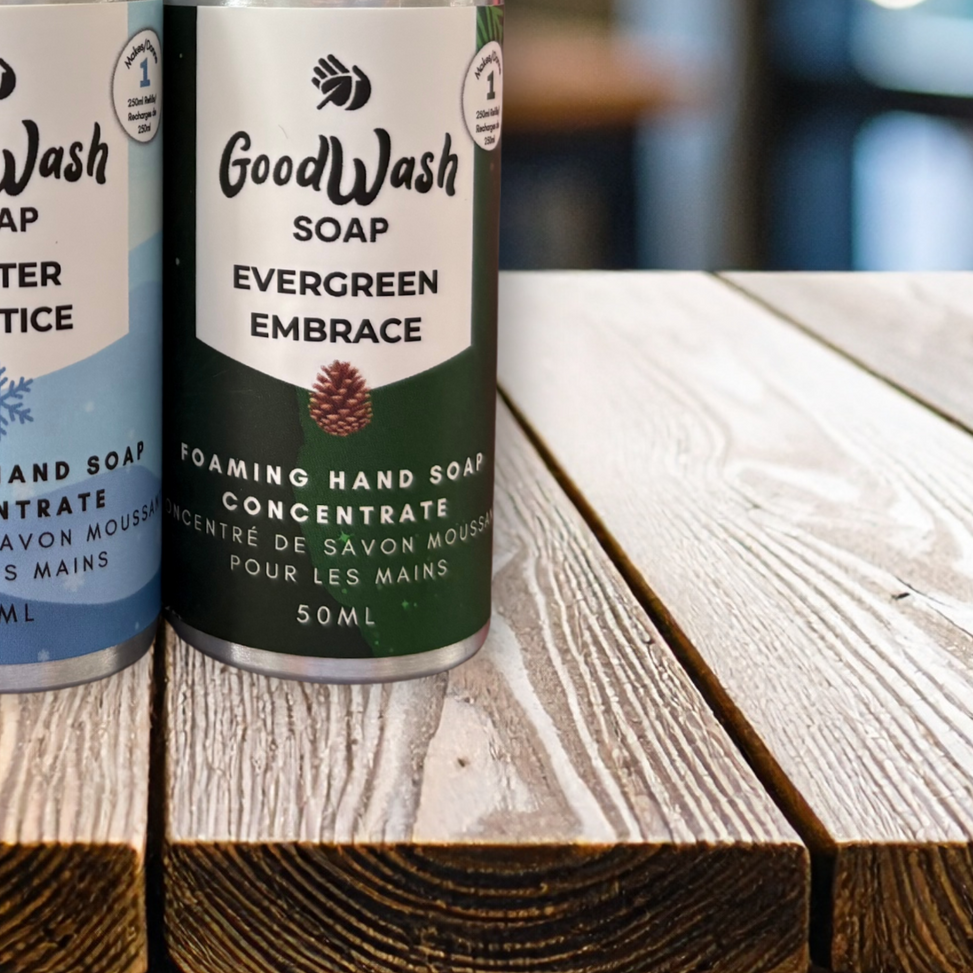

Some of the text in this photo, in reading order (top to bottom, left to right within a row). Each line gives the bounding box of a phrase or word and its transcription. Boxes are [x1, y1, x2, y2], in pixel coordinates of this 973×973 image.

[139, 57, 151, 88] 1
[486, 70, 496, 101] 1
[218, 127, 458, 207] GoodWash
[292, 215, 389, 243] SOAP
[232, 264, 438, 298] EVERGREEN
[250, 311, 422, 344] EMBRACE
[86, 440, 144, 475] SOAP
[181, 442, 483, 490] FOAMING HAND SOAP
[222, 491, 448, 525] CONCENTRATE
[275, 534, 306, 553] DE
[323, 536, 414, 556] SAVON
[33, 551, 109, 579] MAINS
[230, 554, 448, 585] POUR LES MAINS
[296, 604, 375, 626] 50ML
